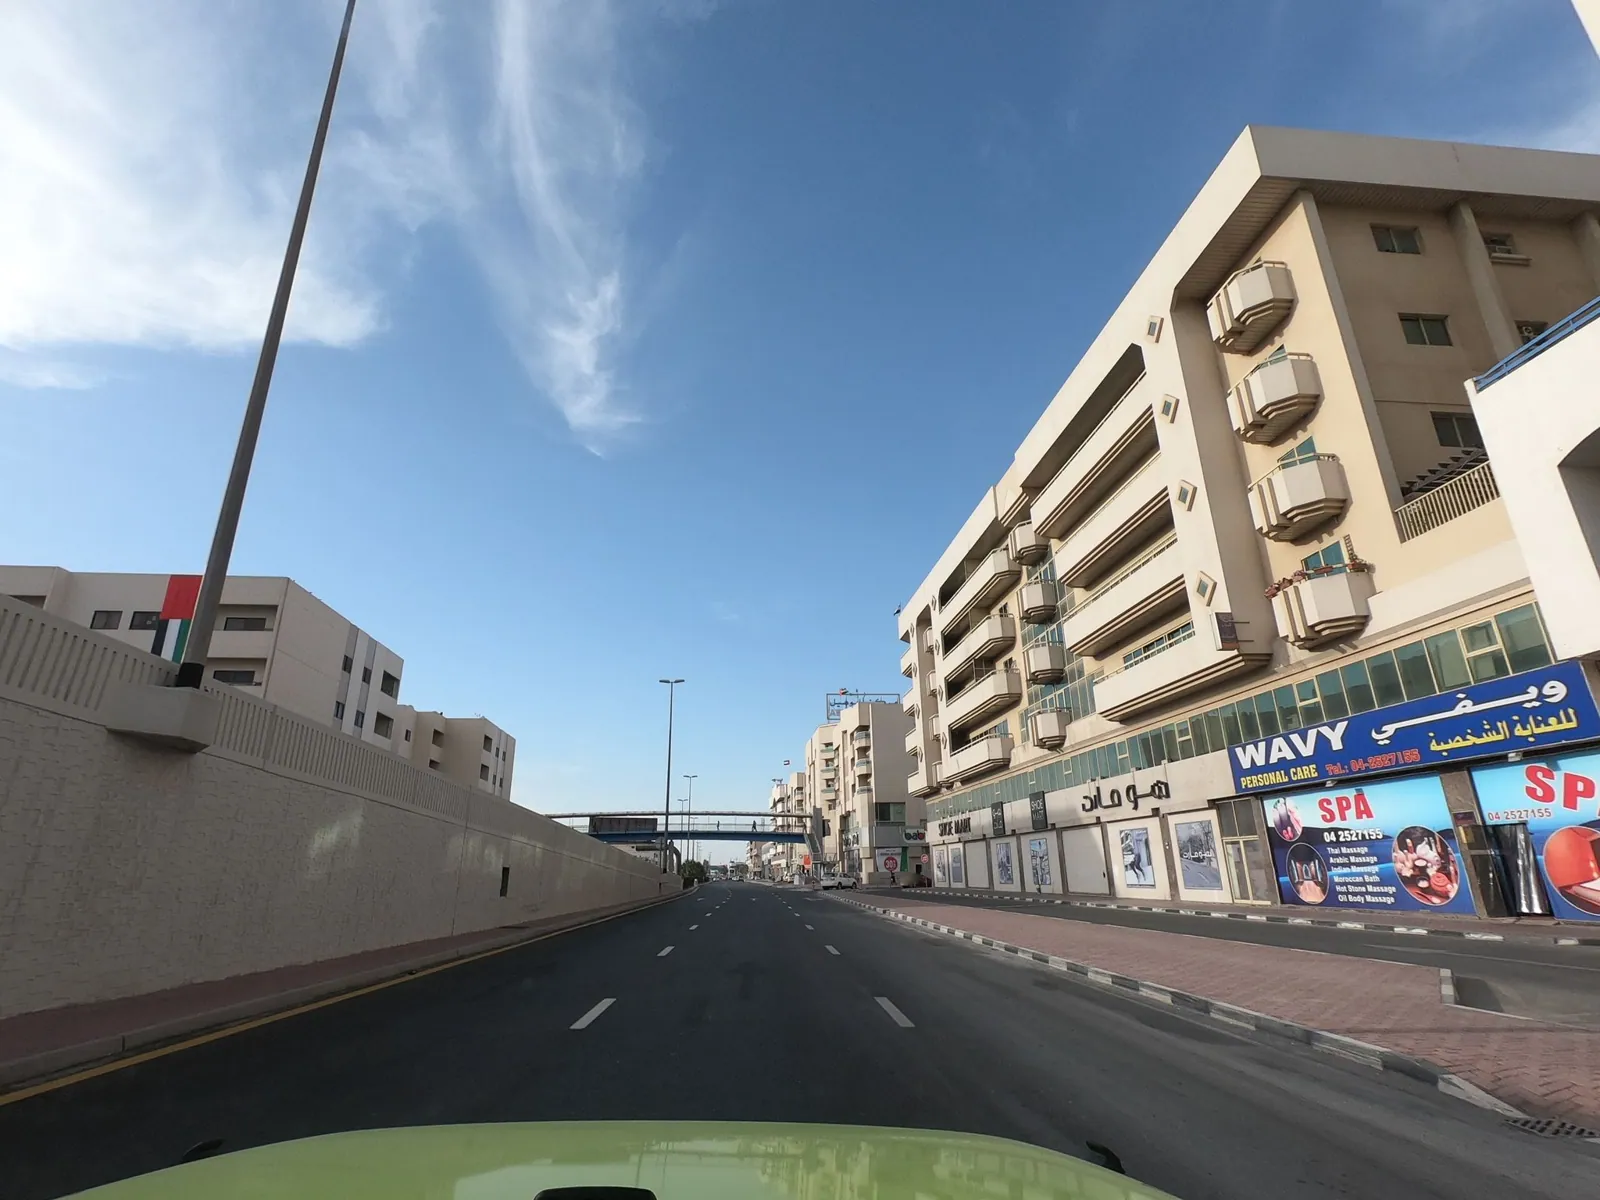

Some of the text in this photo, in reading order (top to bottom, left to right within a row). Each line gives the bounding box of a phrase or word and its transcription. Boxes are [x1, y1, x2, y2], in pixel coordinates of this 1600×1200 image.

[1429, 708, 1578, 756] للعناية الشخصية
[1234, 720, 1349, 770] WAVY
[1350, 748, 1421, 772] 04-2527155
[1240, 764, 1319, 789] PERSONAL CARE
[1525, 764, 1600, 817] SP
[1031, 799, 1044, 811] SHOE
[1317, 793, 1374, 823] SPA
[1488, 808, 1552, 821] 04 2527155
[1323, 828, 1383, 842] 04 2527155
[1341, 846, 1368, 854] Massage
[1349, 855, 1378, 864] Massage
[1350, 865, 1379, 874] Massage
[1347, 884, 1366, 892] Stone
[1366, 885, 1397, 894] Massage
[1337, 894, 1395, 905] Oil Body Massage
